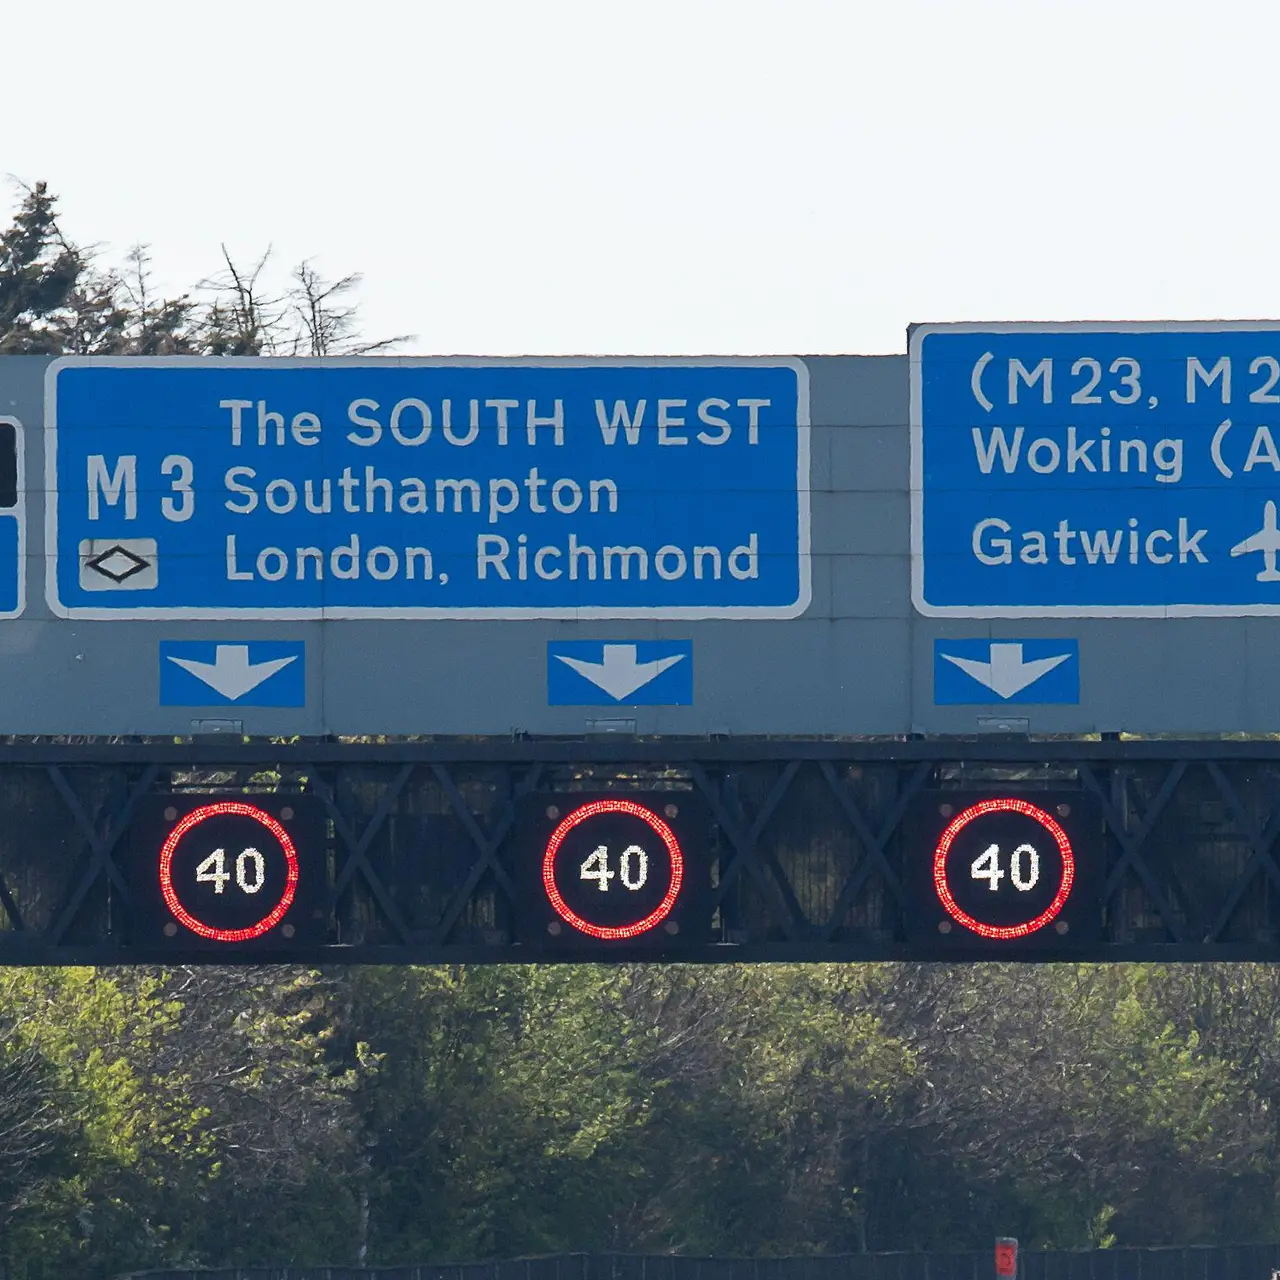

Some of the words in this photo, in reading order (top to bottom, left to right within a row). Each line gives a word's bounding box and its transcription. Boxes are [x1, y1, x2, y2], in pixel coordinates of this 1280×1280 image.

[219, 399, 321, 446] The
[347, 398, 564, 446] SOUTH
[595, 397, 771, 446] WEST
[972, 427, 1183, 483] Woking
[224, 466, 618, 524] Southampton
[227, 534, 450, 588] London,
[477, 533, 758, 580] Richmond
[972, 517, 1209, 565] Gatwick
[195, 846, 266, 894] 40
[579, 845, 649, 892] 40
[969, 844, 1041, 892] 40
